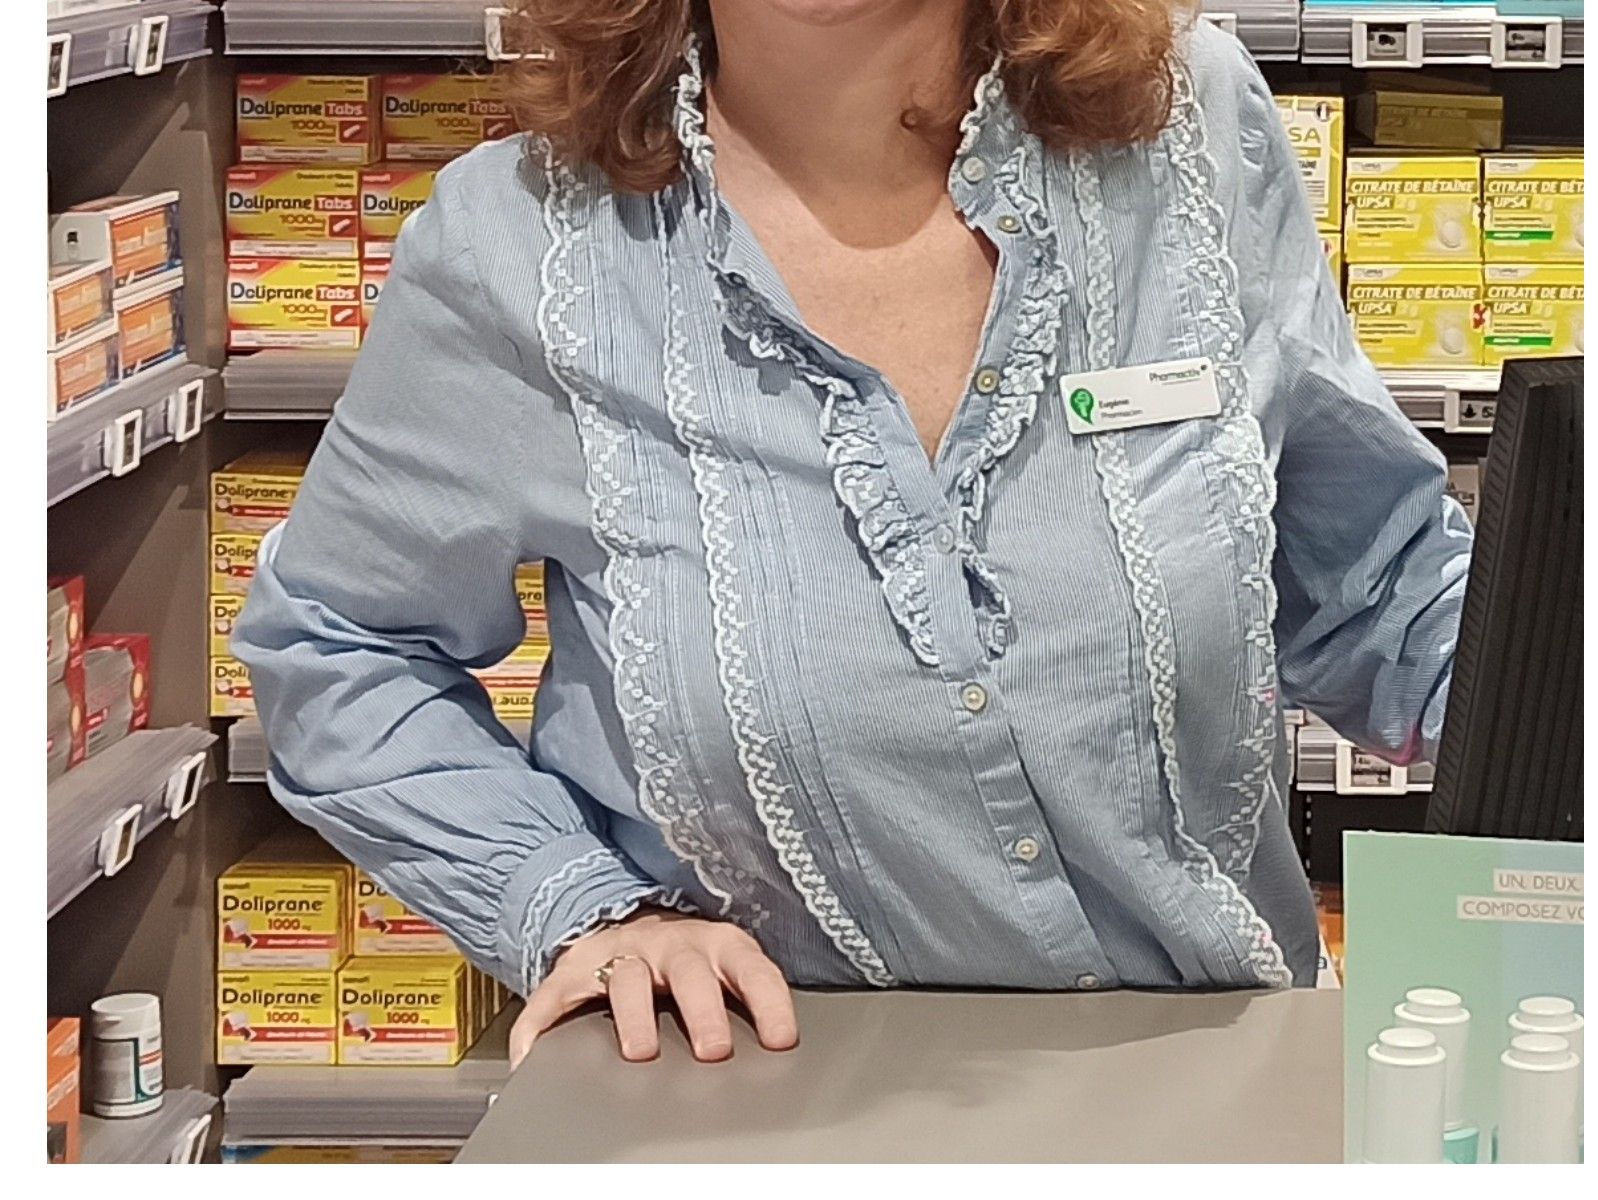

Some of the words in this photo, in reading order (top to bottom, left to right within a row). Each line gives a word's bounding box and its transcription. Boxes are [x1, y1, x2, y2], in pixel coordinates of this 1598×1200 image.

[240, 98, 322, 117] Doliprane
[327, 102, 363, 116] Tabs
[385, 96, 467, 115] Doliprane
[471, 100, 506, 114] Tabs
[1288, 127, 1321, 143] SA
[1351, 180, 1402, 193] CITRATE
[1403, 180, 1419, 193] DE
[1488, 180, 1539, 193] CITRATE
[1541, 180, 1557, 193] DE
[229, 192, 312, 212] Doliprane
[317, 196, 353, 211] Tabs
[1356, 197, 1392, 208] UPSA
[1493, 197, 1528, 208] UPSA
[230, 282, 313, 301] Doliprane
[316, 287, 355, 300] Tabs
[1353, 287, 1403, 300] CITRATE
[1405, 287, 1420, 299] DE
[1488, 286, 1539, 299] CITRATE
[1541, 286, 1556, 299] DE
[1358, 302, 1393, 314] UPSA
[1493, 302, 1528, 314] UPSA
[215, 483, 289, 499] Doliprane
[222, 894, 323, 914] Doliprane
[1463, 901, 1560, 921] COMPOSEZ
[267, 918, 300, 931] 1000
[222, 987, 323, 1008] Doliprane
[342, 988, 442, 1008] Doliprane
[266, 1011, 300, 1024] 1000
[387, 1011, 419, 1024] 1000
